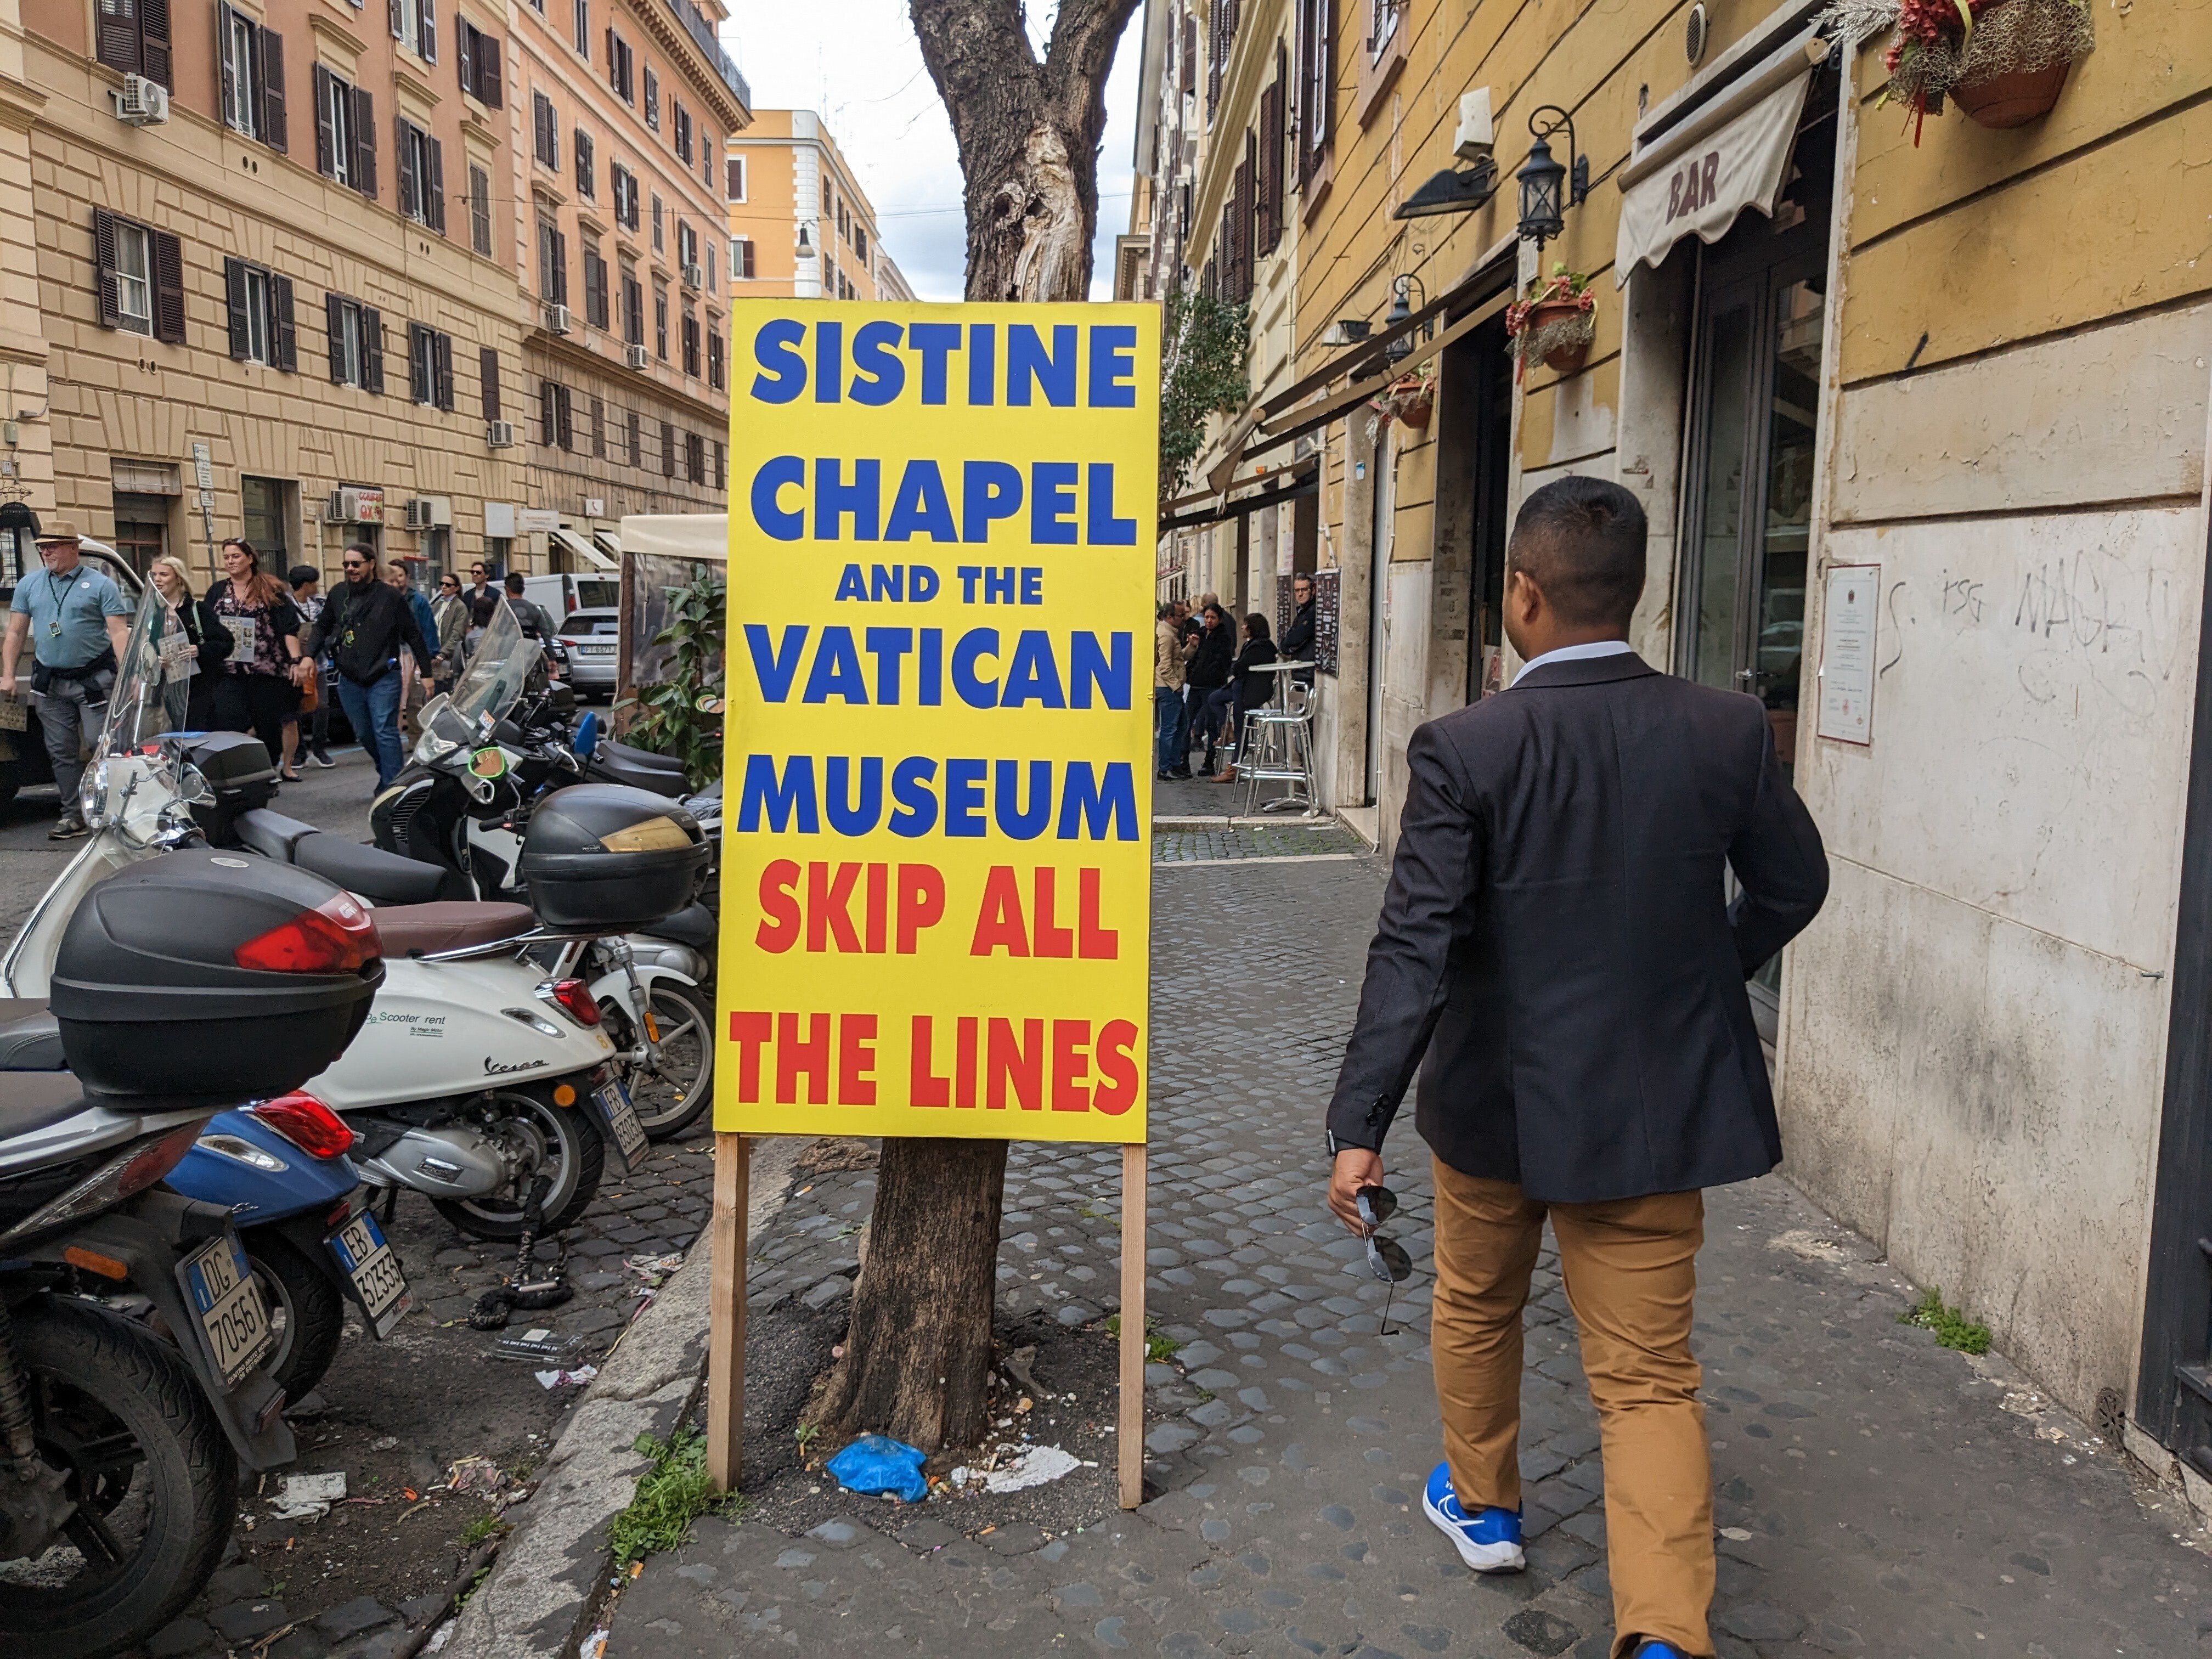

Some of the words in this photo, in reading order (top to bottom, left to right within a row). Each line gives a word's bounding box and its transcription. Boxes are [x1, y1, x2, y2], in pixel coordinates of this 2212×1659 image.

[1666, 151, 1719, 225] BAR
[751, 319, 1136, 407] SISTINE
[751, 456, 1136, 545] CHAPEL
[836, 564, 939, 602] AND
[958, 566, 1042, 605] THE
[744, 625, 1132, 709] VATICAN
[737, 755, 1139, 840] MUSEUM
[754, 858, 946, 955] SKIP
[969, 865, 1119, 961] ALL
[380, 1012, 420, 1023] Scooter
[425, 1016, 446, 1025] rent
[484, 1056, 550, 1076] Vespa
[729, 1011, 878, 1107] THE
[909, 1014, 1139, 1116] LINES
[604, 1088, 622, 1115] FB
[202, 1250, 230, 1301] DG
[342, 1226, 369, 1262] EB
[357, 1251, 401, 1308] 32333
[209, 1286, 263, 1365] 70561
[228, 1364, 245, 1385] CENTRO
[245, 1350, 258, 1367] MOTO
